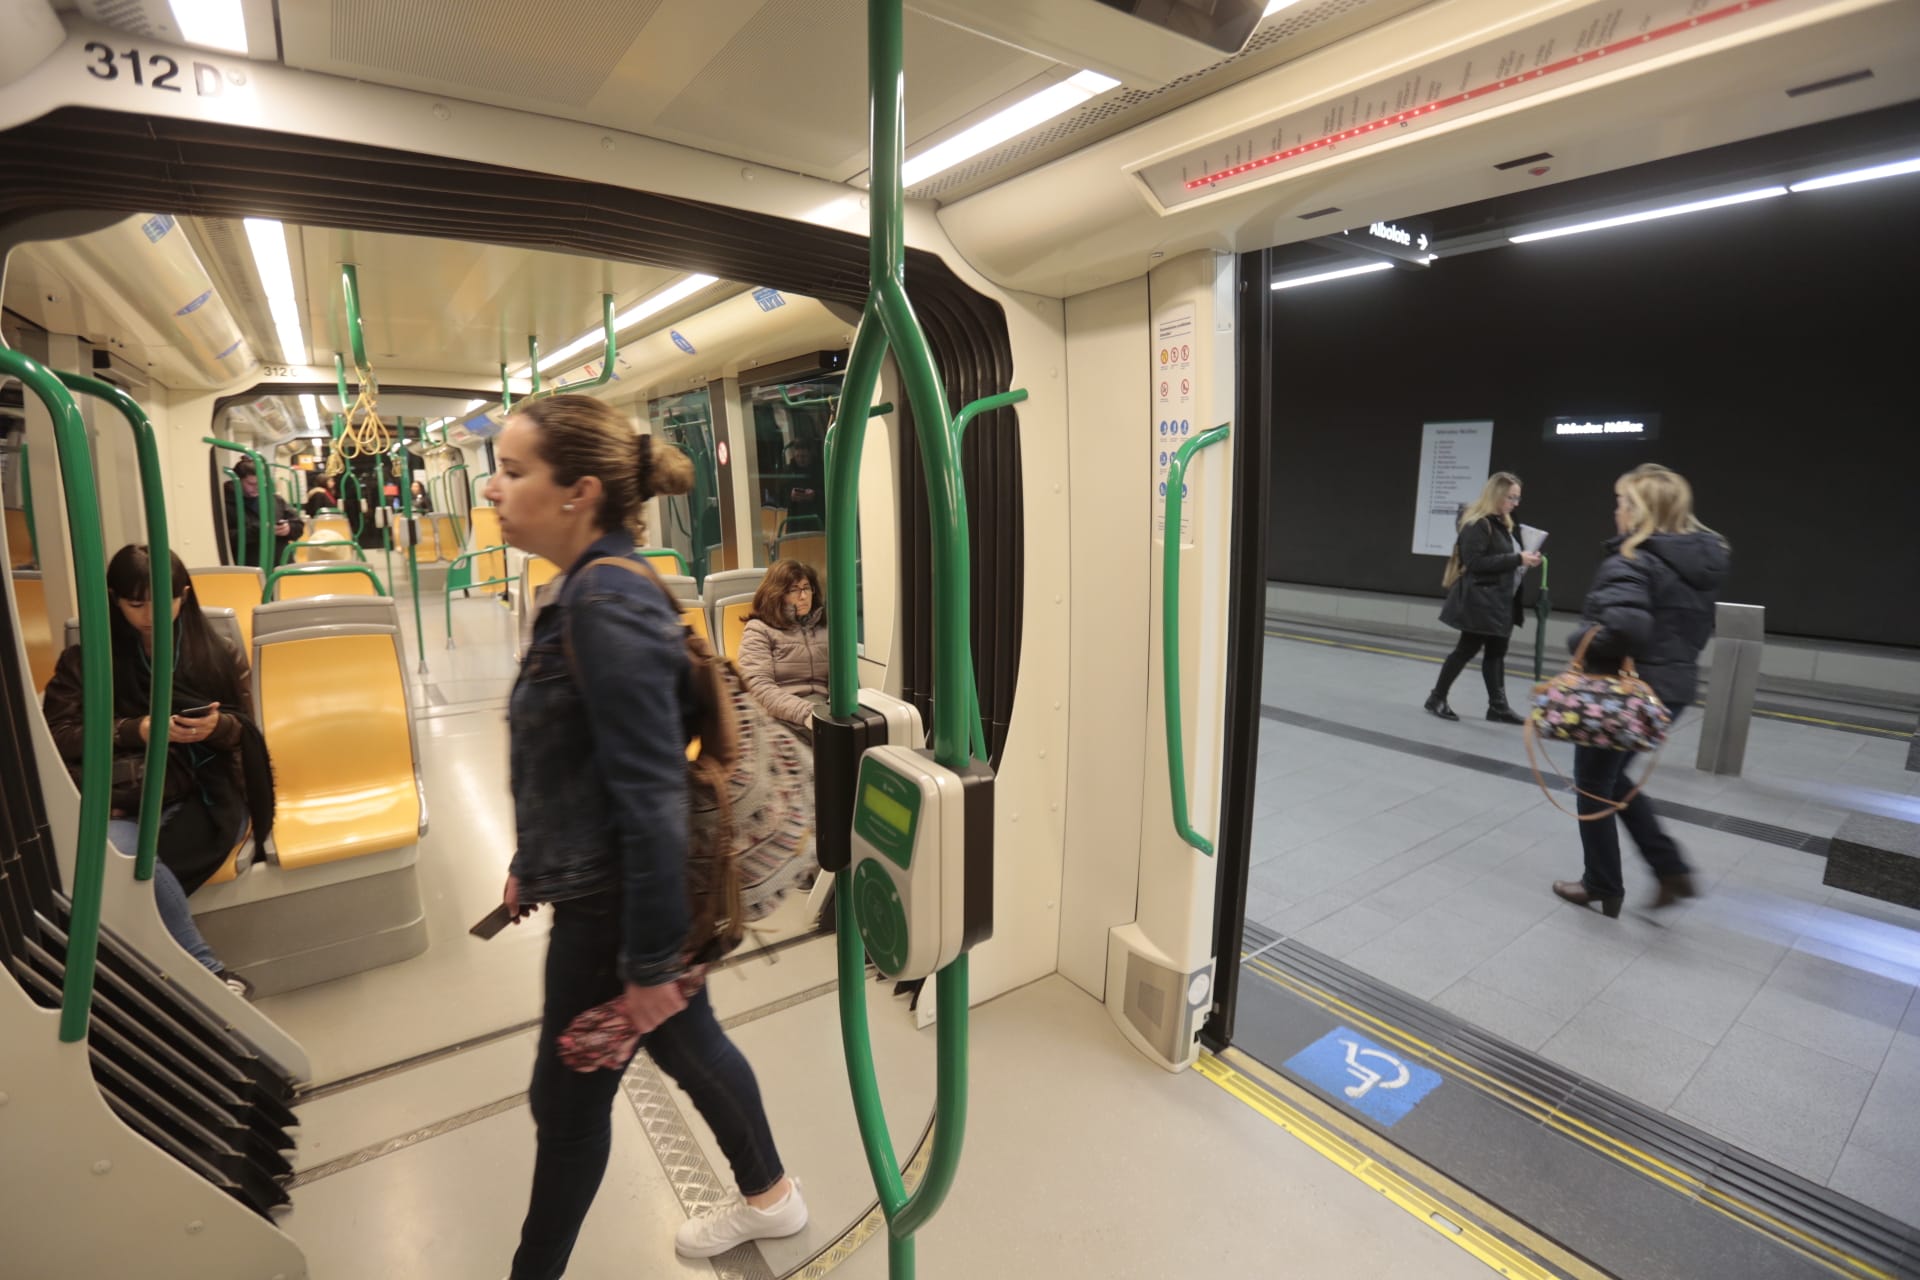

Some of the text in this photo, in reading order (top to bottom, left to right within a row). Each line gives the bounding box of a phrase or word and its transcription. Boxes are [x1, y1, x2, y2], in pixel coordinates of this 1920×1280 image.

[84, 42, 182, 92] 312
[1369, 221, 1411, 246] Albolote
[263, 366, 288, 377] 312
